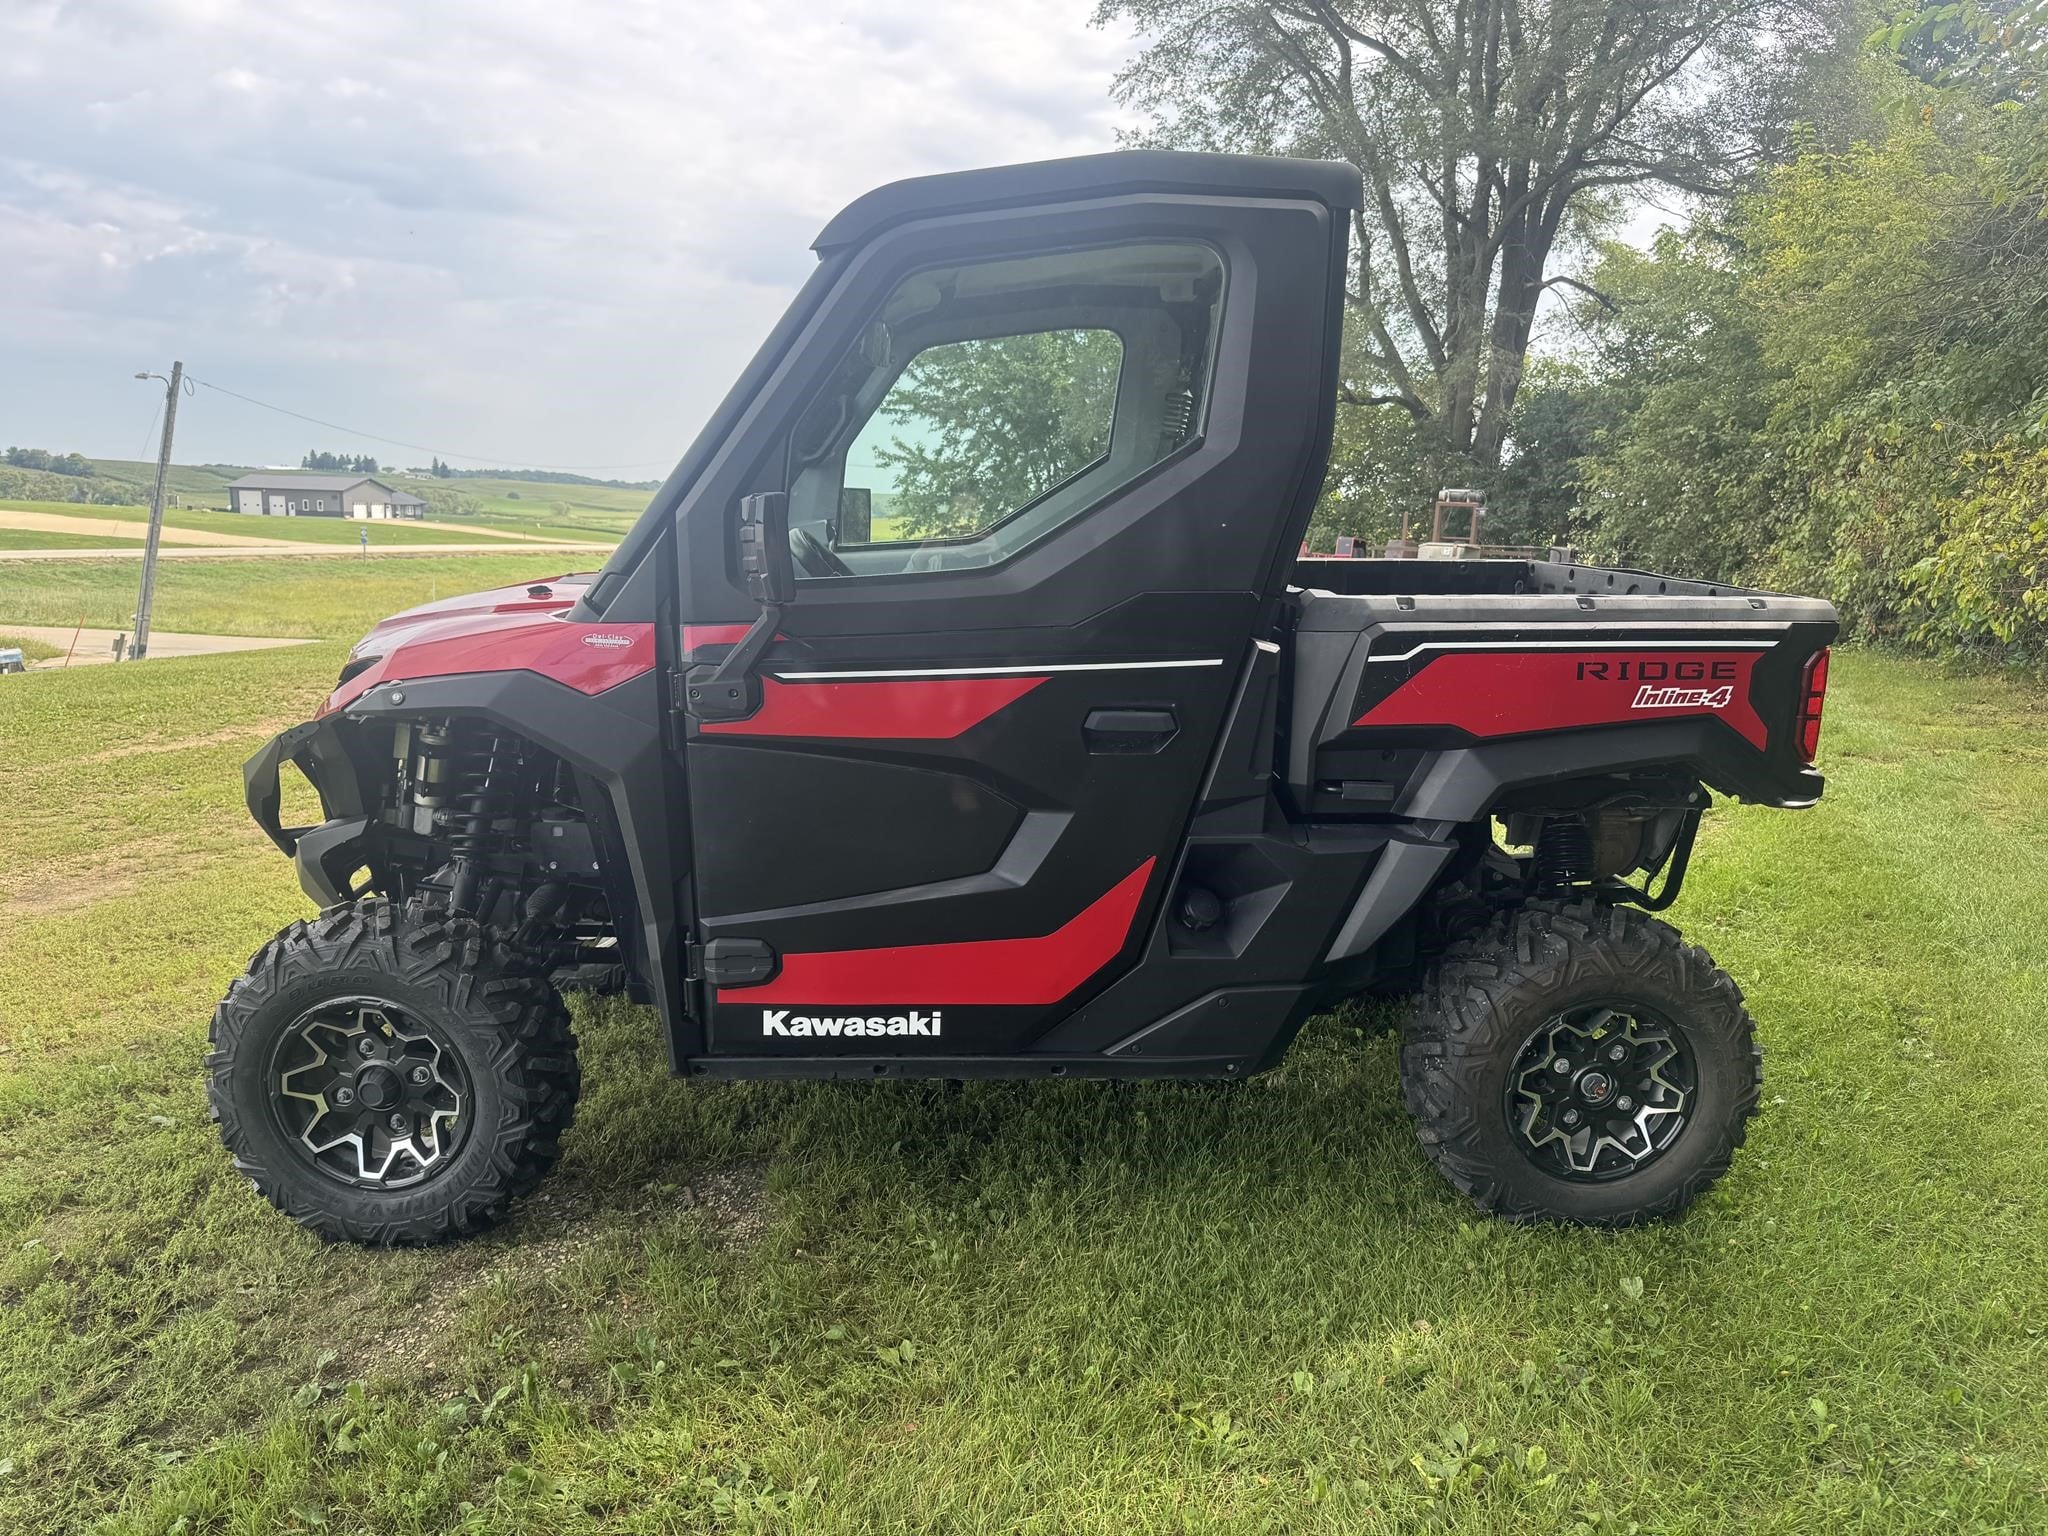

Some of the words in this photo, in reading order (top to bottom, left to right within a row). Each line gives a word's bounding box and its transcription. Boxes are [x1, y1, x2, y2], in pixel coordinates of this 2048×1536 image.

[1577, 661, 1737, 681] RIDGE
[1631, 685, 1734, 708] Inline-4
[762, 1009, 942, 1037] Kawasaki
